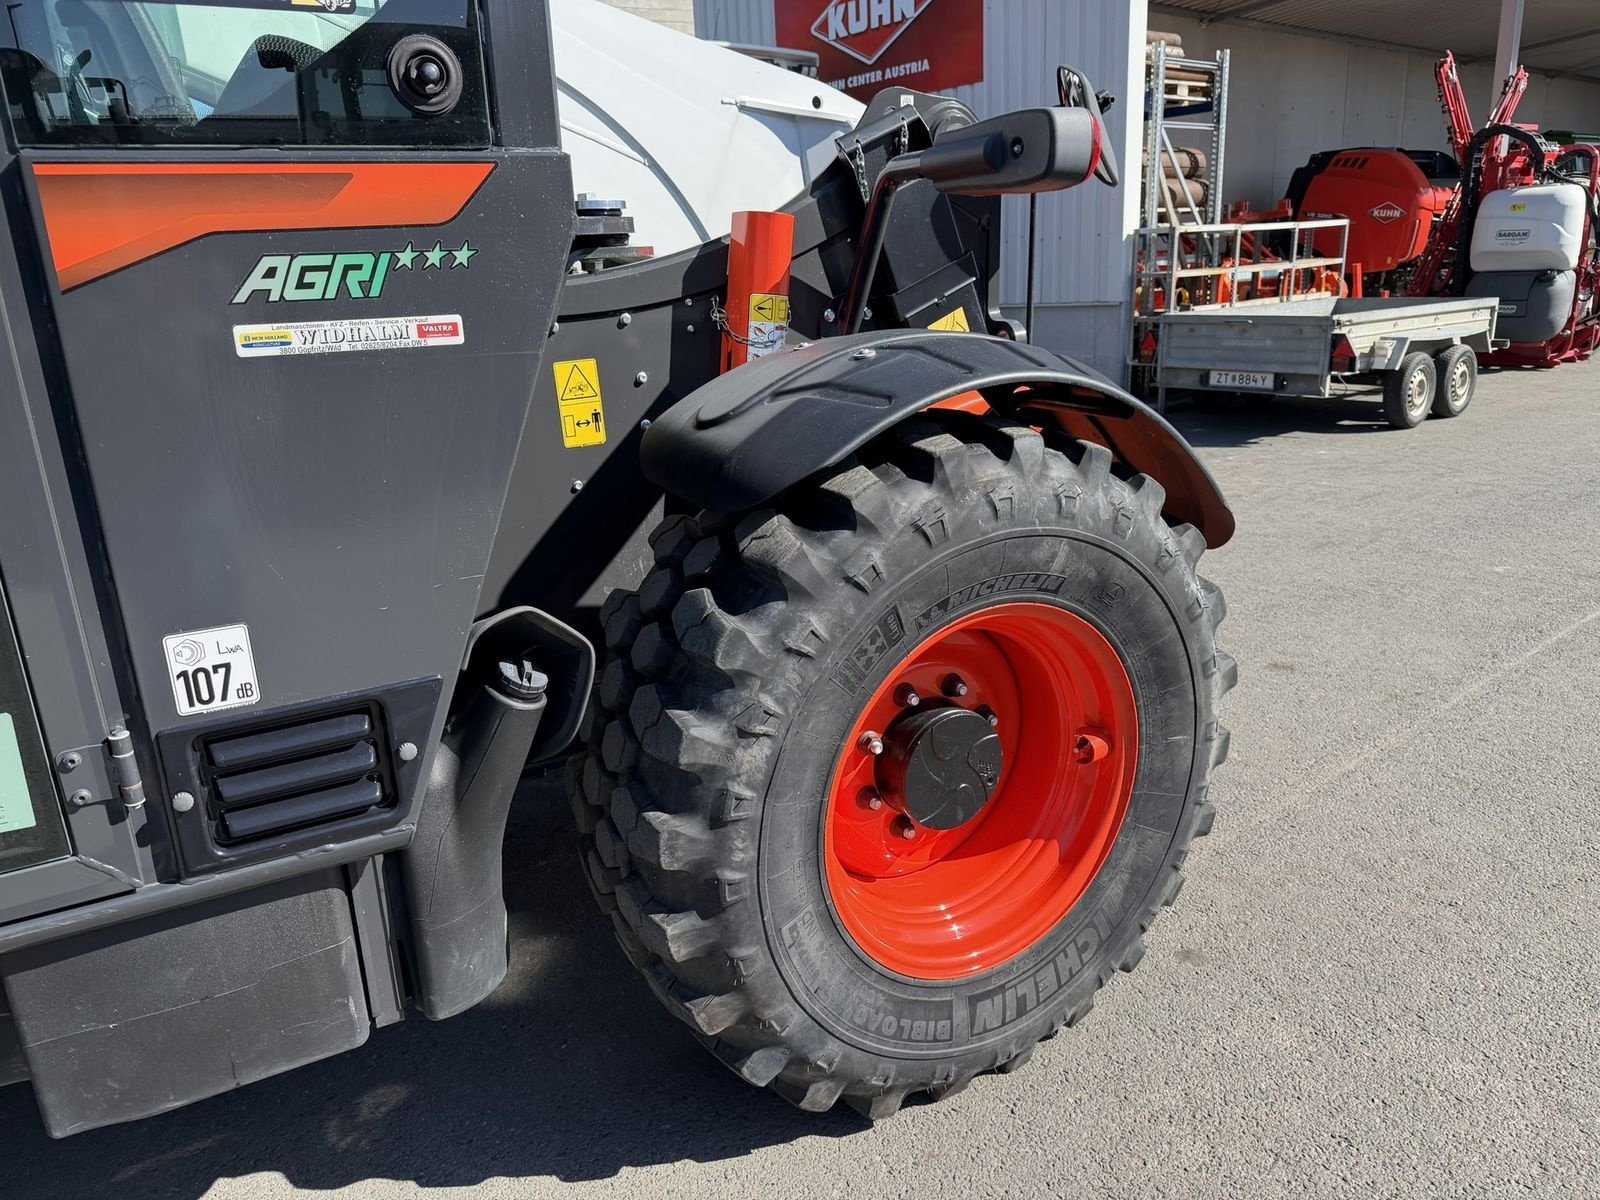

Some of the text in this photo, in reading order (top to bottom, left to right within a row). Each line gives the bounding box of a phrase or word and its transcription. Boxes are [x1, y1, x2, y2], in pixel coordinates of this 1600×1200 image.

[827, 0, 915, 41] KUHN
[847, 70, 882, 88] CENTER
[884, 59, 930, 80] AUSTRIA
[1372, 208, 1401, 217] KUHN
[230, 252, 392, 304] AGRI
[271, 322, 325, 331] Landmaschinen
[294, 324, 411, 346] WIDHALM
[422, 324, 454, 332] VALTRA
[279, 346, 296, 355] 3800
[1216, 372, 1267, 386] ZT 884 Y
[950, 574, 1065, 607] MICHELIN
[175, 662, 231, 708] 107
[236, 682, 254, 699] dB
